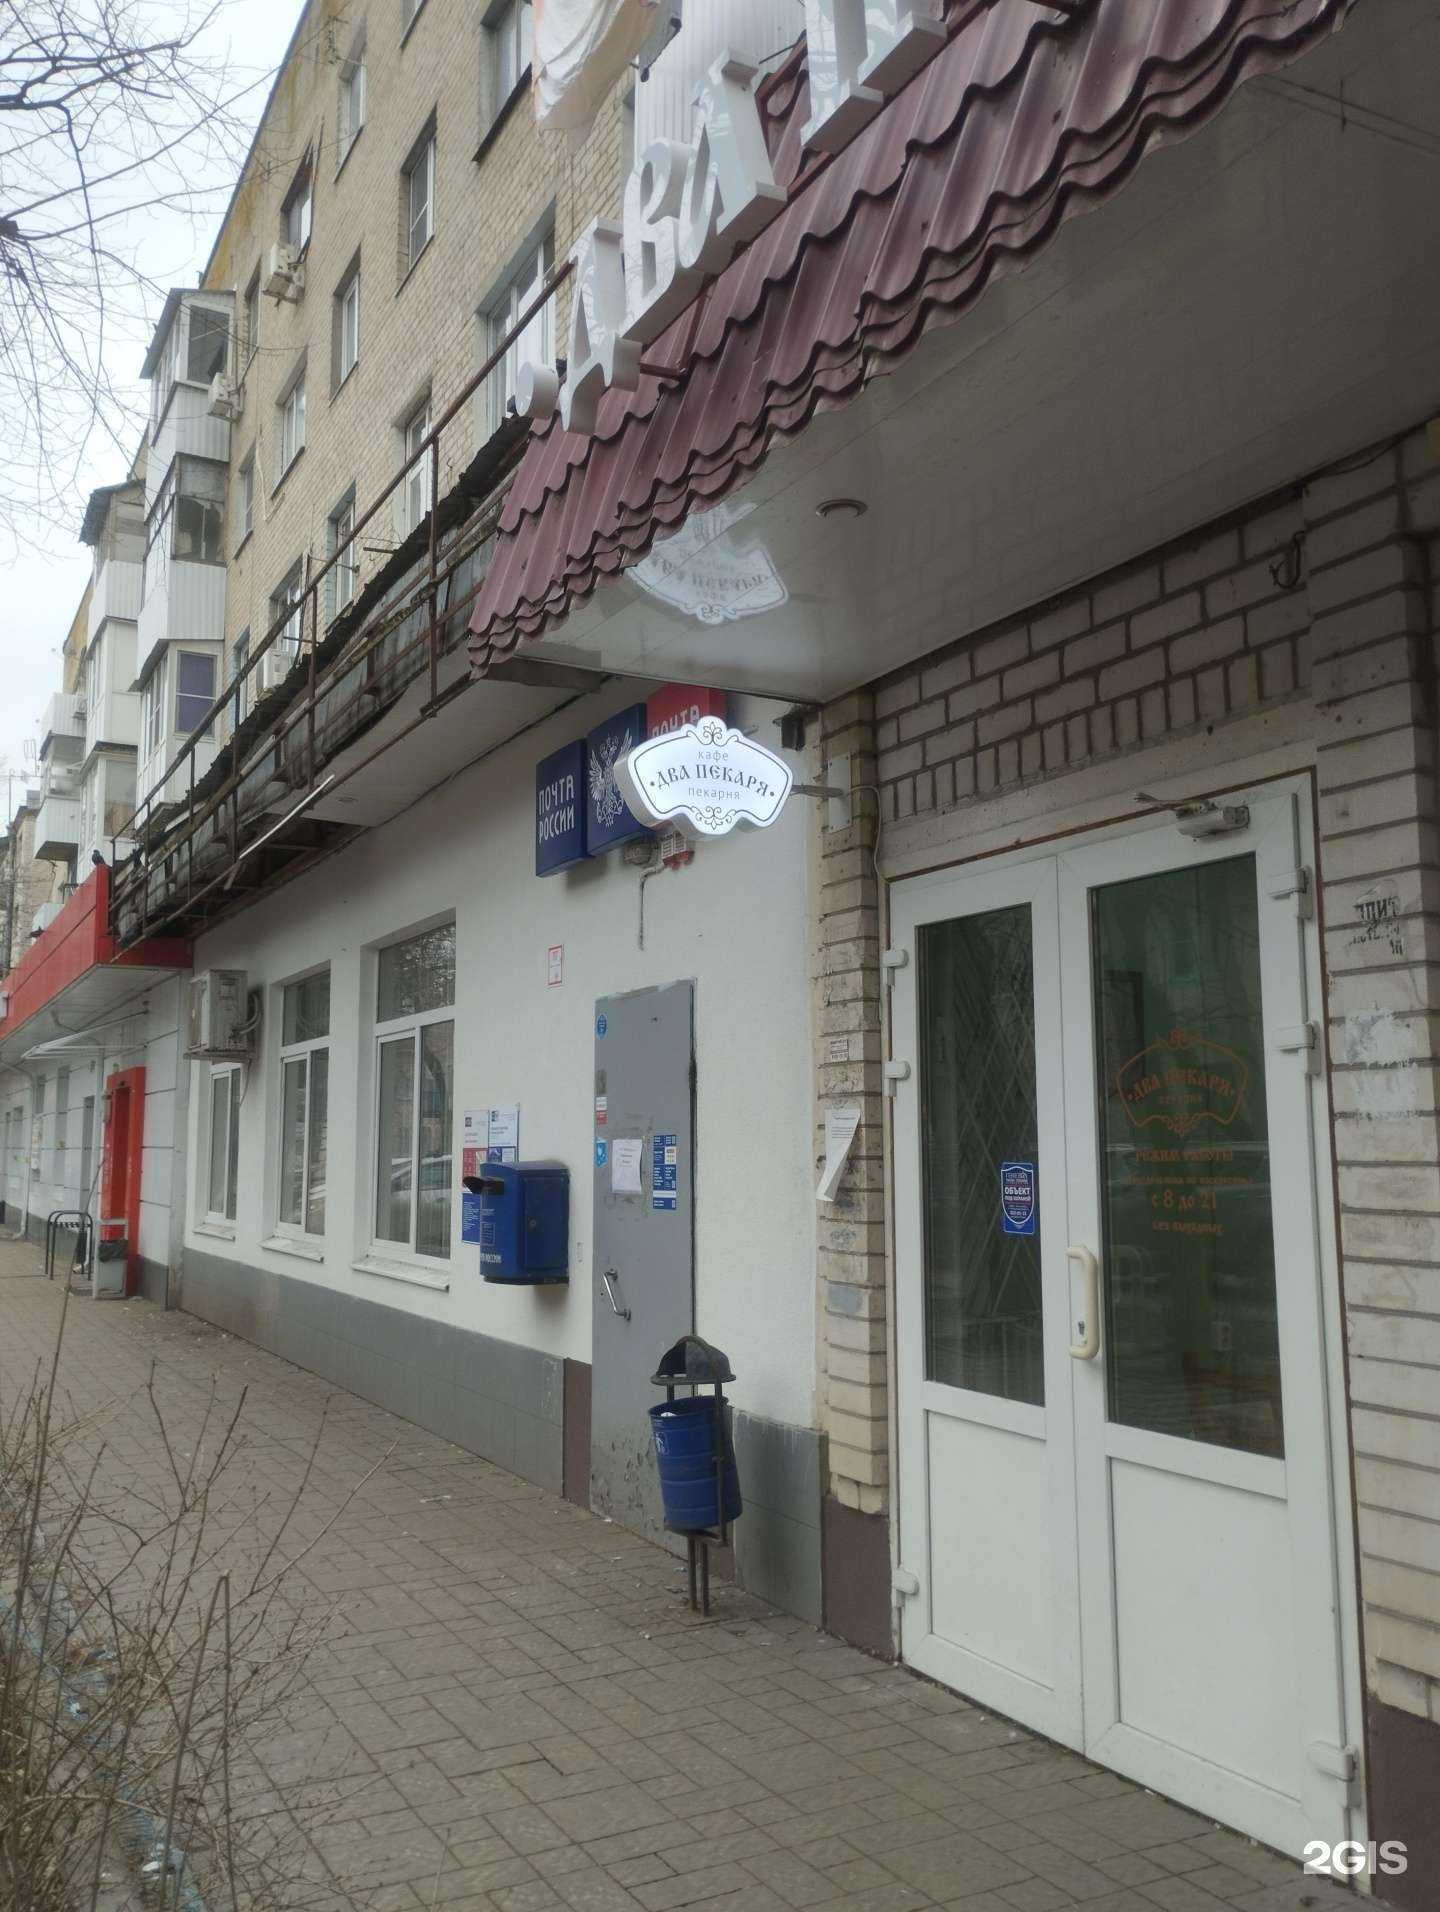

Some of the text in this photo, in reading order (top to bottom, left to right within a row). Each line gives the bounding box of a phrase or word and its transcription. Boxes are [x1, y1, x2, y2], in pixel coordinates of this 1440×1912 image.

[698, 749, 729, 763] кафе
[657, 764, 769, 797] ДВА ПЕКАРЯ
[538, 774, 574, 815] ПОЧТА
[688, 787, 740, 801] пекарня
[538, 804, 575, 845] РОССИИ
[1004, 1187, 1030, 1195] ОБЪЕКТ
[1163, 1188, 1174, 1209] 8
